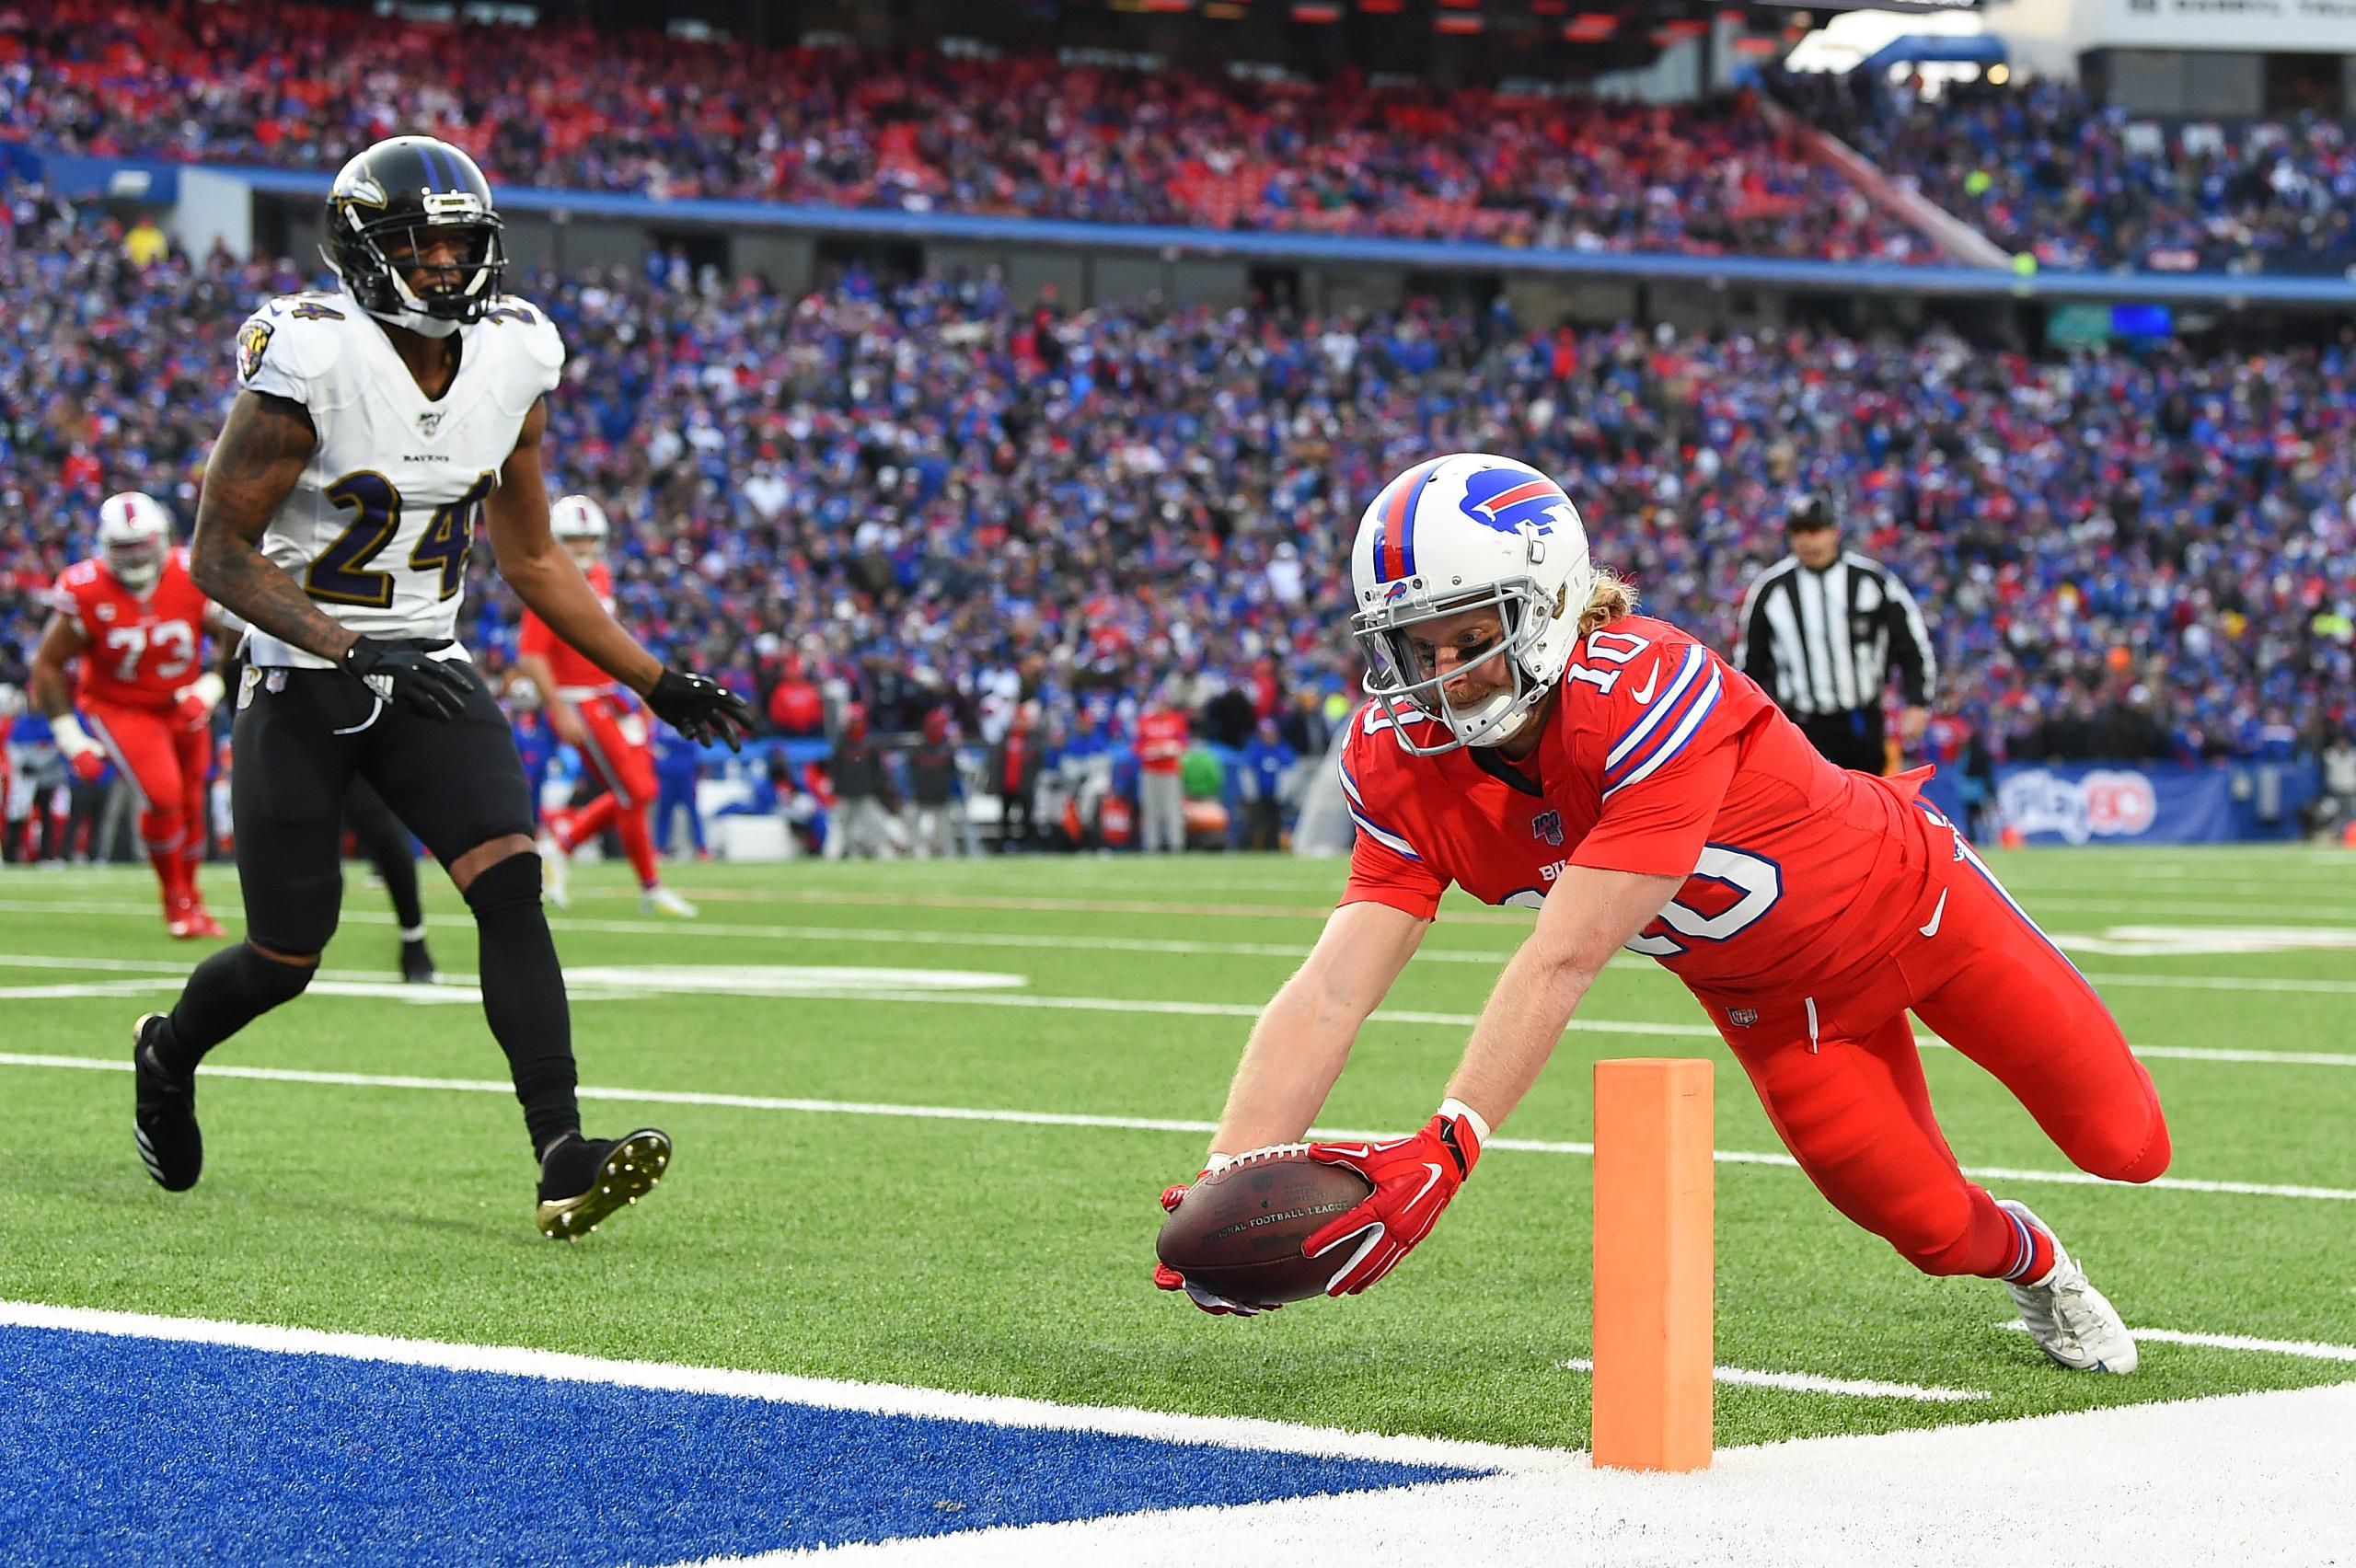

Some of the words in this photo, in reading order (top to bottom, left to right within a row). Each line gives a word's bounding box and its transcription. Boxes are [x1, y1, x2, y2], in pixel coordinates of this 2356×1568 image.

[305, 469, 498, 608] 24
[106, 618, 194, 682] 73
[1567, 629, 1651, 697] 10
[1249, 1206, 1305, 1228] FOOTBALL
[1307, 1200, 1349, 1215] LEAGUE
